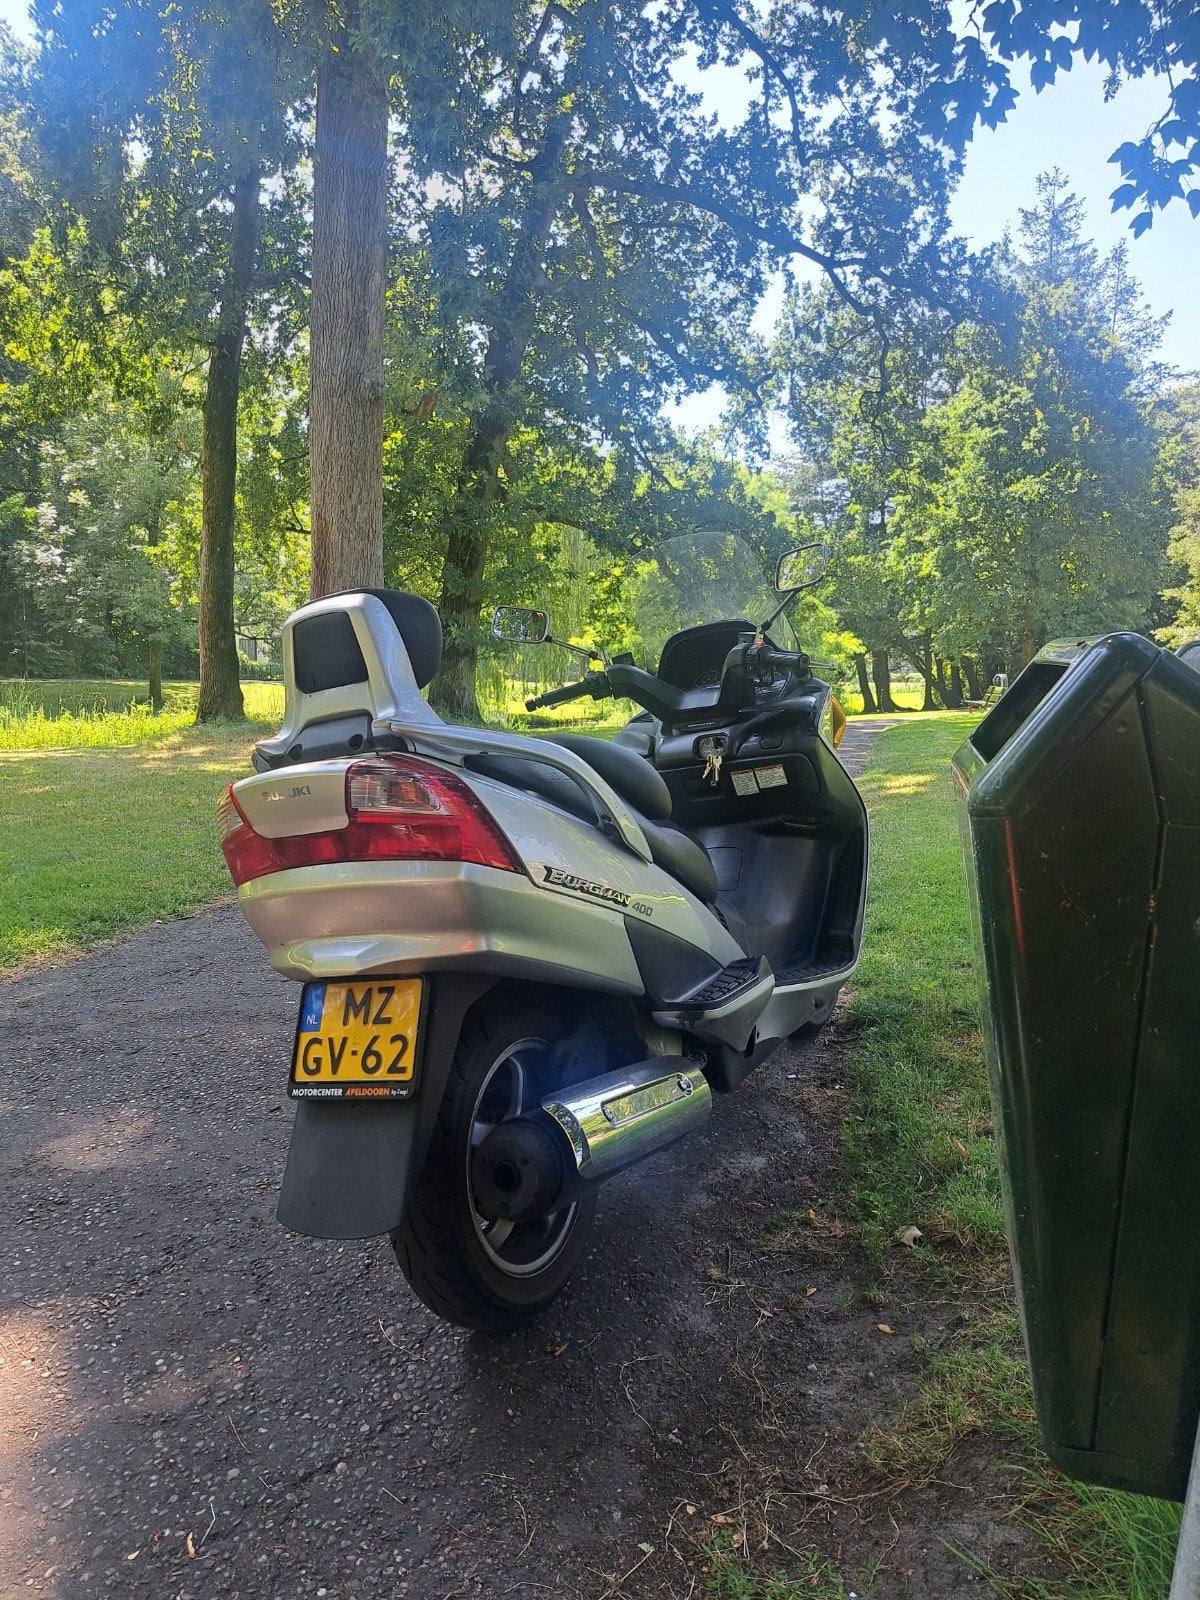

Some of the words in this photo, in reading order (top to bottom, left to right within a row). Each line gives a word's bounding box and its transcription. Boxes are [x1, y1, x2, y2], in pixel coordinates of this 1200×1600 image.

[546, 866, 632, 907] BURGMAN
[631, 901, 653, 917] 400
[306, 1015, 318, 1025] NL
[342, 986, 396, 1026] MZ
[302, 1034, 409, 1076] GV-62
[292, 1088, 343, 1097] MOTORCENTER
[345, 1087, 390, 1096] APELDOORN
